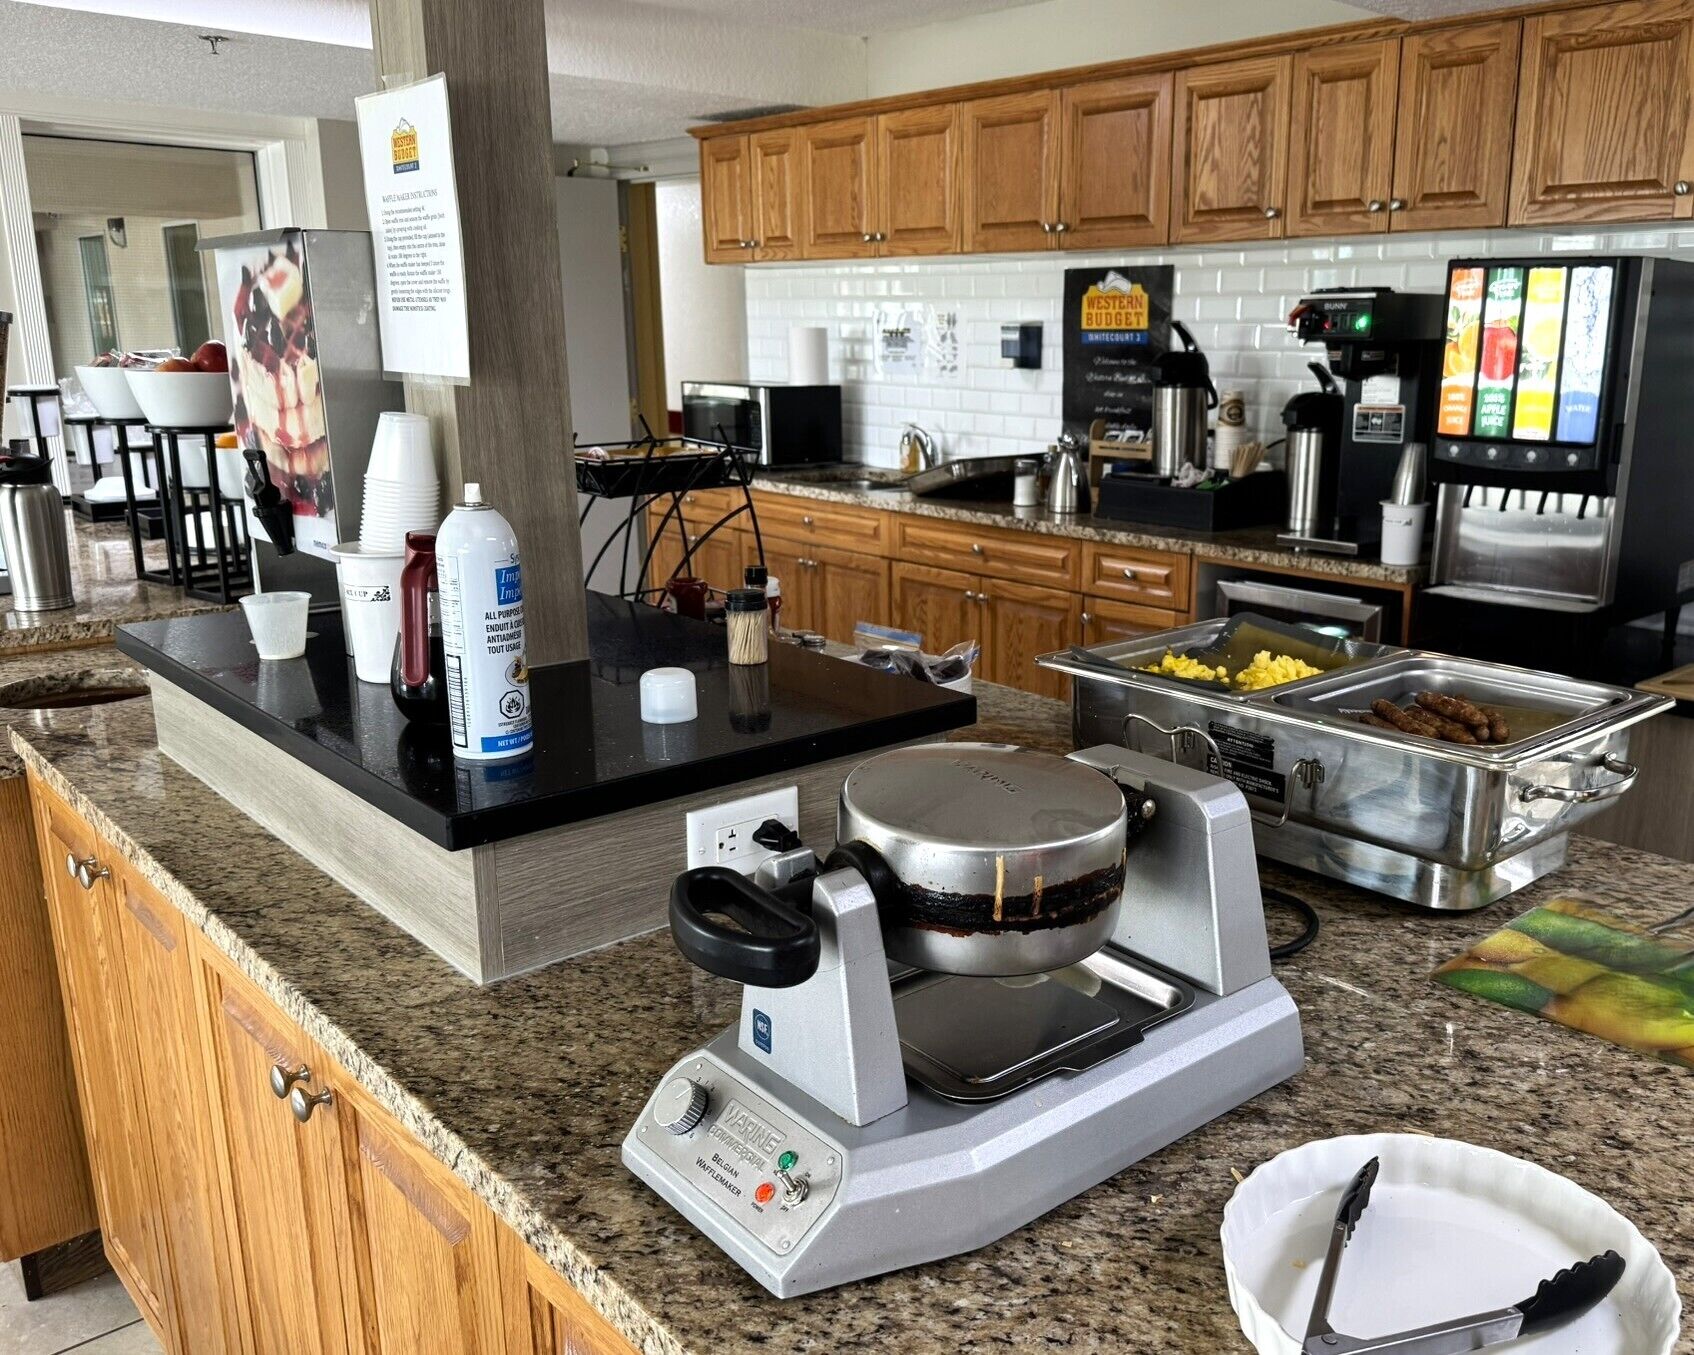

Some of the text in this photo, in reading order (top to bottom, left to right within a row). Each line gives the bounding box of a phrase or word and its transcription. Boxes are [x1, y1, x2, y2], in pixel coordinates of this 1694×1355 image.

[392, 134, 416, 148] WESTERN
[394, 146, 416, 160] BUDGET
[1086, 296, 1143, 310] WESTERN
[1324, 302, 1347, 310] BUNN
[1086, 312, 1143, 327] BUDGET
[1088, 333, 1134, 342] WHITECOURT
[1480, 404, 1507, 415] APPLE
[1565, 404, 1591, 414] WATER
[1480, 415, 1505, 428] JUICE
[510, 553, 520, 564] Sys
[500, 568, 520, 584] Imp
[499, 586, 521, 600] Imp
[485, 611, 497, 620] ALL
[498, 606, 520, 619] PURPOSE
[486, 622, 509, 633] ENDUIT
[488, 641, 521, 654] TOUT USAGE
[498, 739, 508, 747] NET
[1210, 756, 1232, 768] CAION
[757, 1019, 769, 1036] NSF
[723, 1103, 782, 1155] WARING
[707, 1124, 766, 1174] COMMERCIAL
[711, 1152, 740, 1178] BELGIAN
[695, 1156, 742, 1198] WAFFLEMAKER
[750, 1202, 764, 1214] POWER
